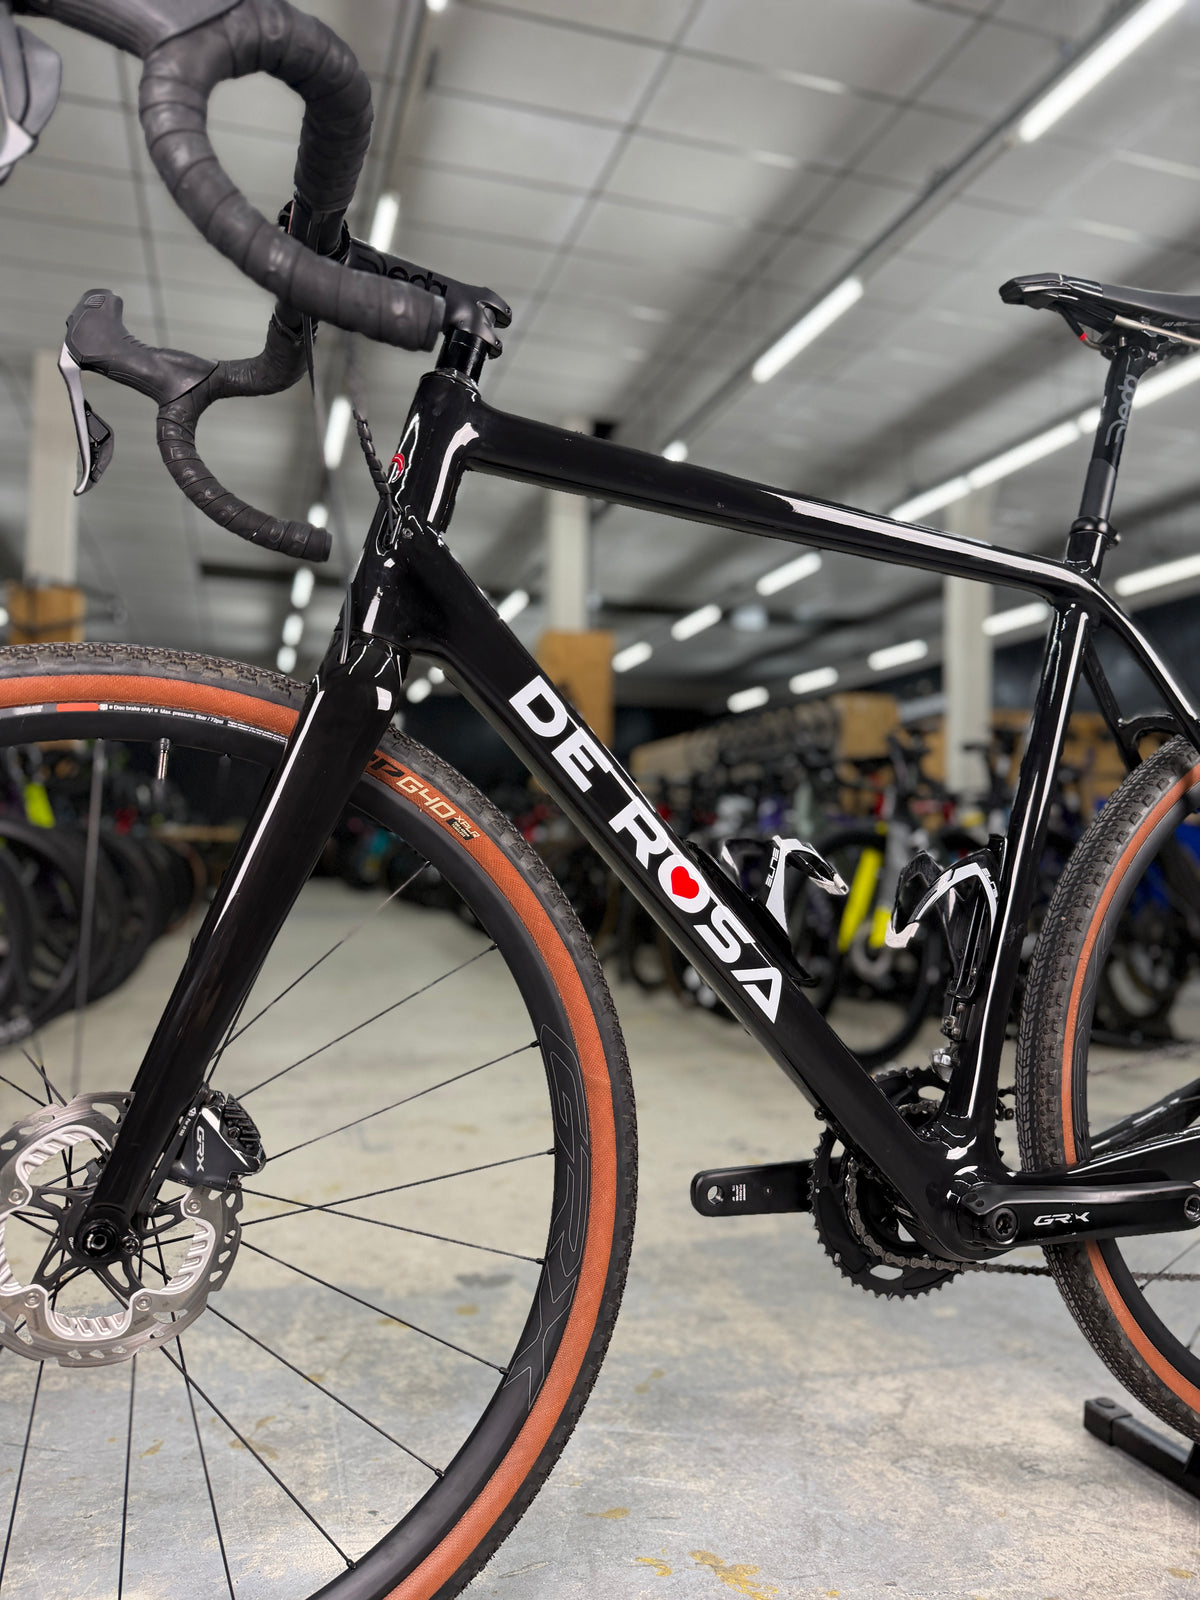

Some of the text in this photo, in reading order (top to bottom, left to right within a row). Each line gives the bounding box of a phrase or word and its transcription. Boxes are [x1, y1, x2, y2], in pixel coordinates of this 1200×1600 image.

[125, 704, 140, 712] brake
[396, 776, 457, 819] G40
[454, 815, 480, 838] XPLR
[509, 675, 783, 1024] DE ROSA
[196, 1126, 205, 1173] GRX
[1033, 1211, 1090, 1226] GRX
